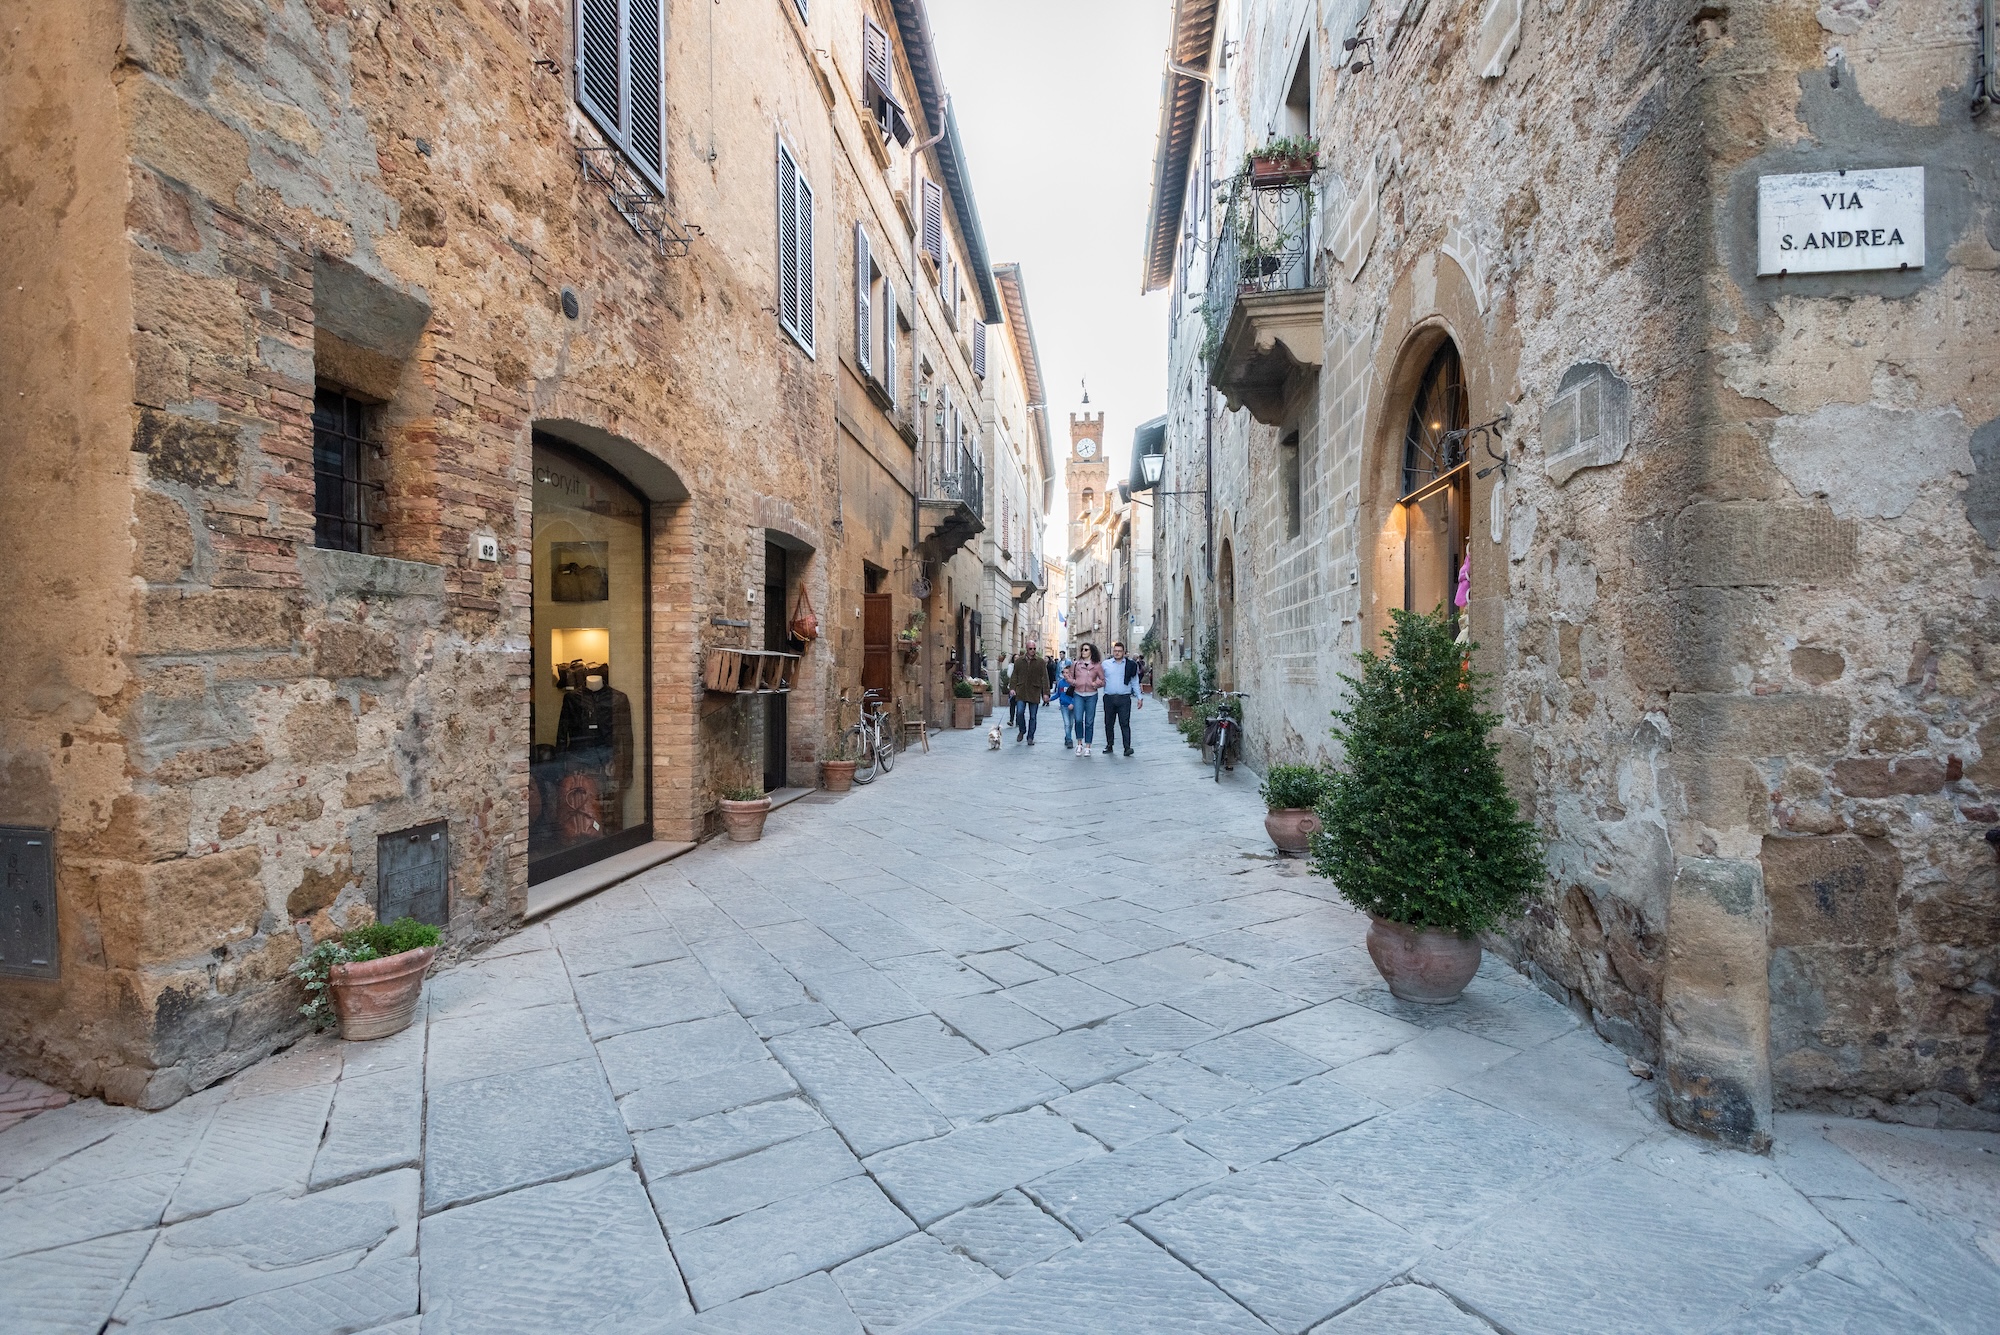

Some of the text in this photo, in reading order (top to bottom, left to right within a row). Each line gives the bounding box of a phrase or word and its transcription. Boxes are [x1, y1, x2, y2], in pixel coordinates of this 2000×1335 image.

[1821, 191, 1864, 211] VIA
[1780, 228, 1905, 251] S. ANDREA
[532, 465, 580, 495] ctory.it
[482, 544, 494, 557] 62
